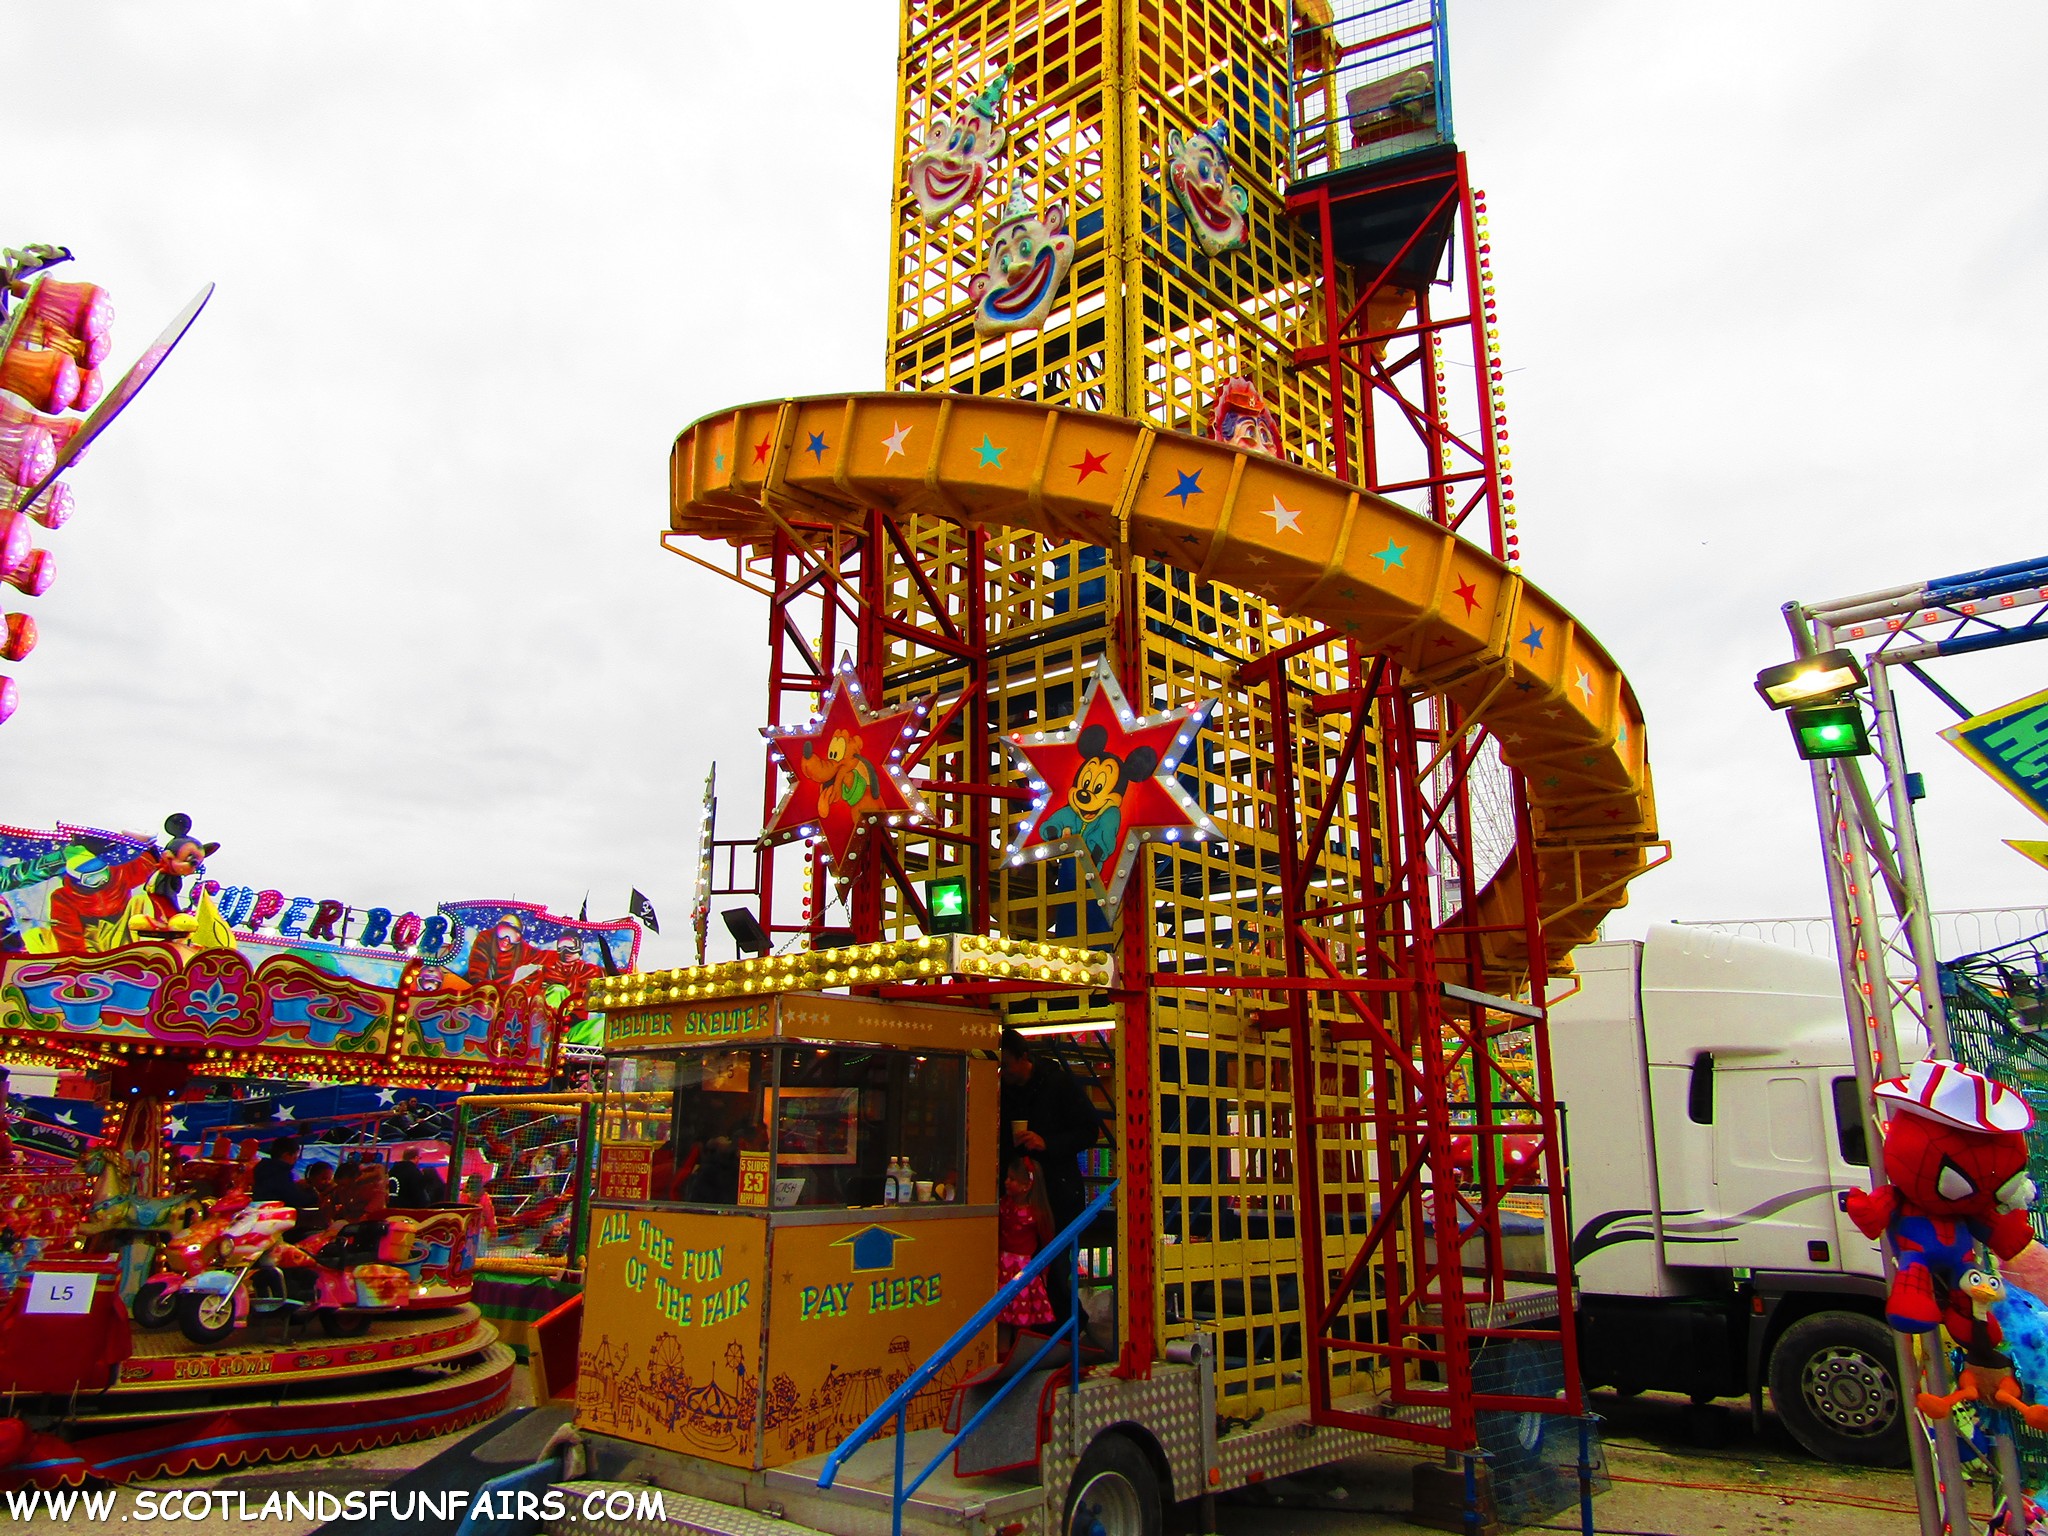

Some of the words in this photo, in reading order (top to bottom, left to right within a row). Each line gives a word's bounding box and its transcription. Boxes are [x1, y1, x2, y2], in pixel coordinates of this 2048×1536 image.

[360, 907, 449, 954] BOB
[608, 1012, 673, 1043] HELTER
[684, 1003, 769, 1037] SKELTER
[741, 1160, 746, 1172] 5
[747, 1160, 769, 1173] SLIDES
[617, 1174, 628, 1186] THE
[629, 1174, 640, 1186] TOP
[743, 1172, 765, 1193] £3
[605, 1186, 613, 1197] OF
[614, 1186, 625, 1198] THE
[626, 1187, 642, 1199] SLIDE
[597, 1212, 631, 1248] ALL
[638, 1218, 675, 1270] THE
[682, 1244, 726, 1283] FUN
[50, 1286, 74, 1301] L5
[625, 1256, 649, 1293] OF
[655, 1276, 693, 1327] THE
[701, 1278, 750, 1328] FAIR
[800, 1282, 854, 1321] PAY
[868, 1272, 943, 1314] HERE
[174, 1359, 216, 1379] TOY
[219, 1355, 274, 1377] TOWN
